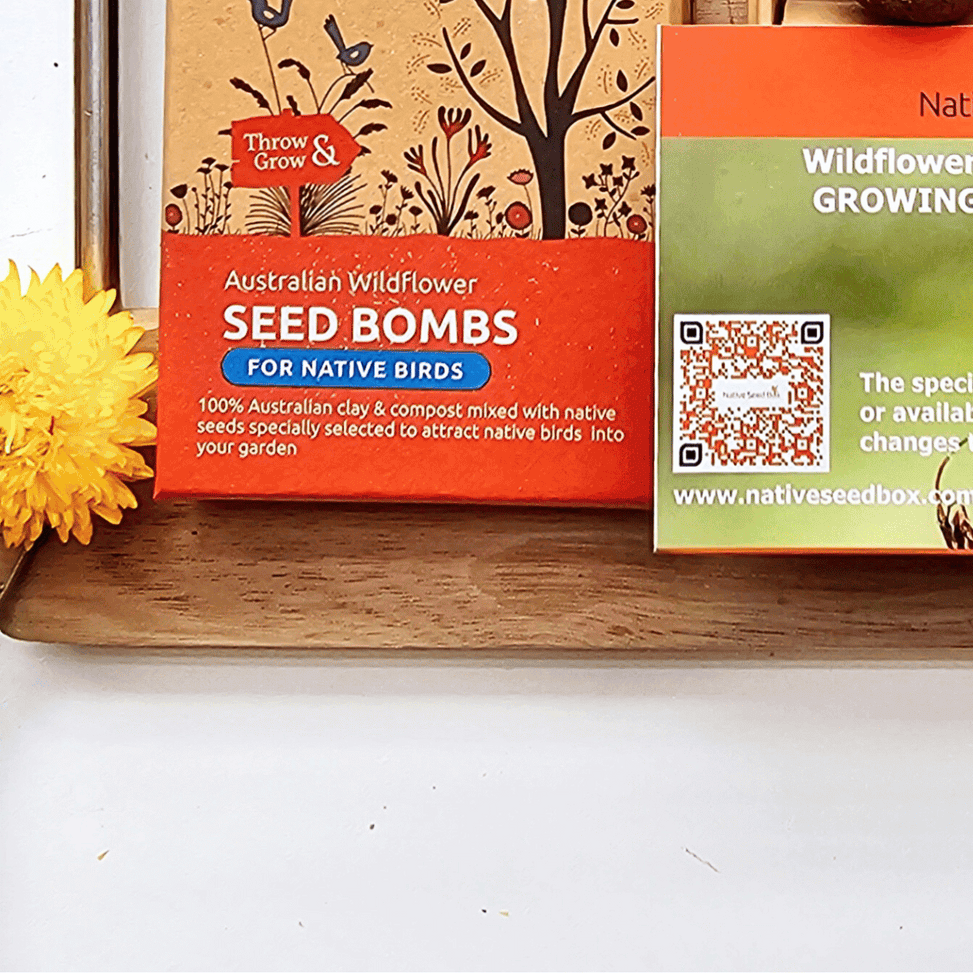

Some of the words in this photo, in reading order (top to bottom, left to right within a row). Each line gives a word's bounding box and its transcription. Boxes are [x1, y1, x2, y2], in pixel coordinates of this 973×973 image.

[243, 133, 308, 151] Throw
[312, 134, 340, 166] &
[254, 152, 307, 170] Grow
[223, 270, 341, 292] Australian
[348, 272, 478, 294] Wildflower
[223, 305, 338, 341] SEED
[352, 307, 518, 345] BOMBS
[248, 358, 293, 377] FOR
[301, 359, 387, 379] NATIVE
[394, 361, 464, 380] BIRDS
[859, 371, 905, 393] The
[198, 397, 245, 414] 100%
[248, 398, 333, 415] Australian
[336, 399, 370, 419] clay
[373, 400, 386, 417] &
[389, 402, 464, 420] compost
[466, 402, 518, 419] mixed
[522, 403, 560, 420] with
[564, 404, 617, 422] native
[859, 405, 886, 422] or
[197, 418, 245, 435] seeds
[249, 419, 321, 439] specially
[324, 420, 395, 438] selected
[400, 423, 418, 439] to
[421, 424, 480, 440] attract
[483, 424, 536, 441] native
[540, 424, 583, 442] birds
[591, 425, 625, 443] into
[196, 442, 235, 457] your
[238, 439, 298, 458] garden
[859, 430, 961, 457] changes
